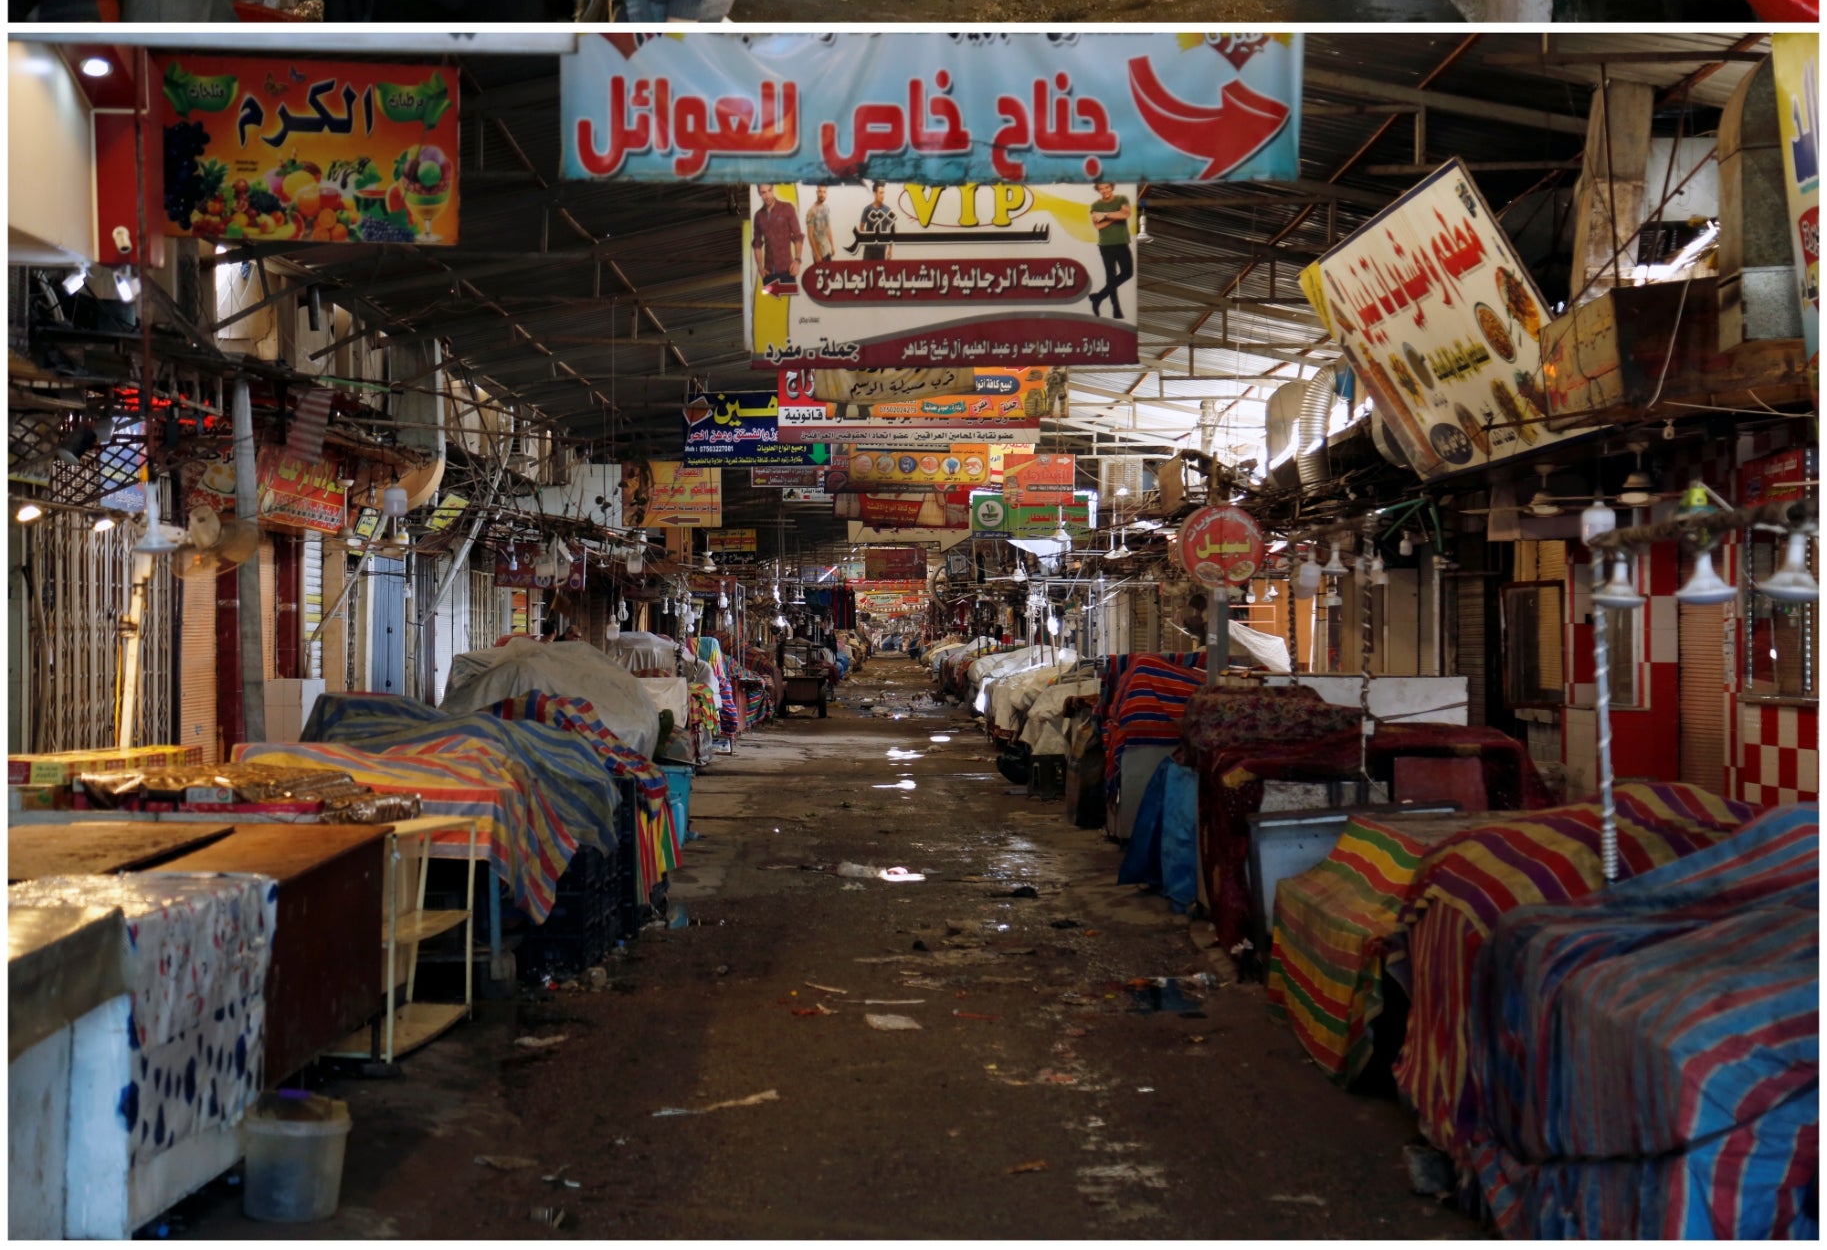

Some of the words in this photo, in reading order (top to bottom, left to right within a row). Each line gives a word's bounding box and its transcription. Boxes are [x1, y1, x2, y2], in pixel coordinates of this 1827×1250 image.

[237, 78, 375, 149] الكرم
[819, 69, 970, 177] خاص
[577, 75, 798, 178] للعوائل
[990, 71, 1119, 181] جناح
[901, 183, 1027, 228] VIP
[843, 209, 1051, 254] سنتر
[1430, 206, 1488, 304] مطعم
[815, 265, 873, 292] الجاهزة
[876, 264, 949, 295] والشبابية
[953, 265, 1017, 295] الرجالية
[1020, 265, 1077, 289] للألبسة
[765, 338, 802, 363] مفرد
[819, 336, 860, 363] جملة
[900, 338, 928, 360] ظاهر
[929, 337, 950, 358] شيخ
[962, 337, 992, 359] العليم
[992, 339, 1011, 355] عبد
[1021, 337, 1052, 357] الواحد
[1053, 338, 1073, 356] عبد
[986, 378, 999, 389] كافة
[784, 408, 823, 424] قانونية
[895, 431, 909, 440] عضو
[950, 431, 978, 441] المحامين
[979, 431, 996, 441] نقابة
[997, 431, 1013, 440] عضو
[1195, 532, 1251, 559] نبيل
